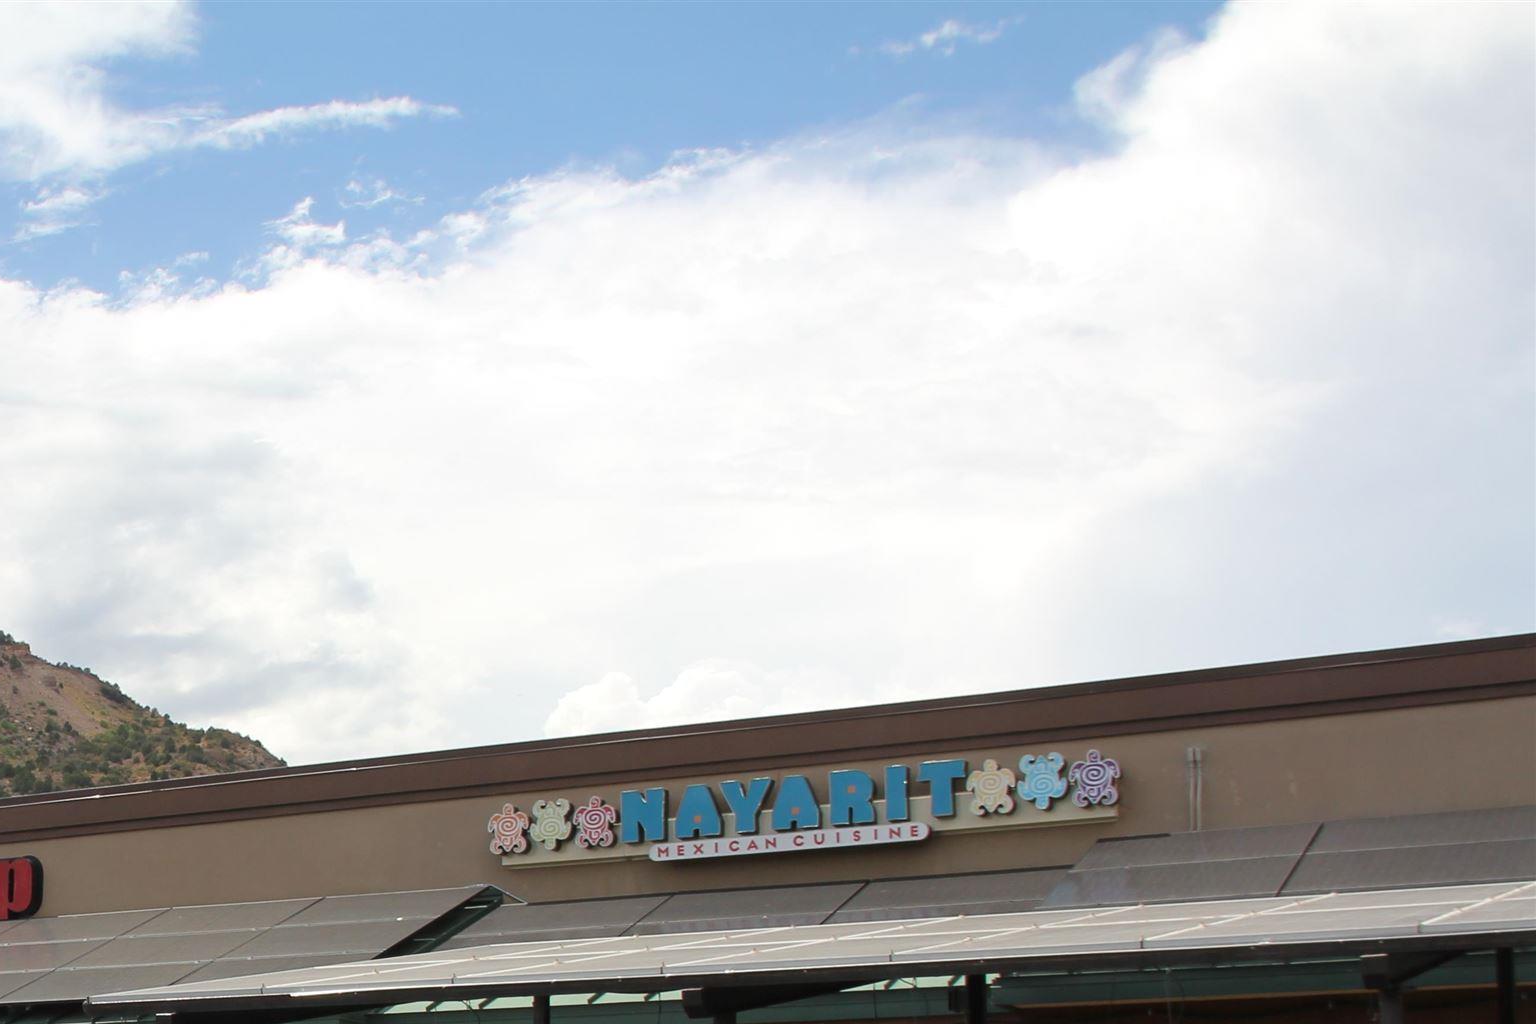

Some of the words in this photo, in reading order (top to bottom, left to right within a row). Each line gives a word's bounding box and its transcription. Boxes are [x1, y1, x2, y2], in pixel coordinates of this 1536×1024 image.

[620, 759, 966, 845] NAYARIT
[657, 837, 778, 858] MEXICAN
[792, 825, 920, 847] CUISINE
